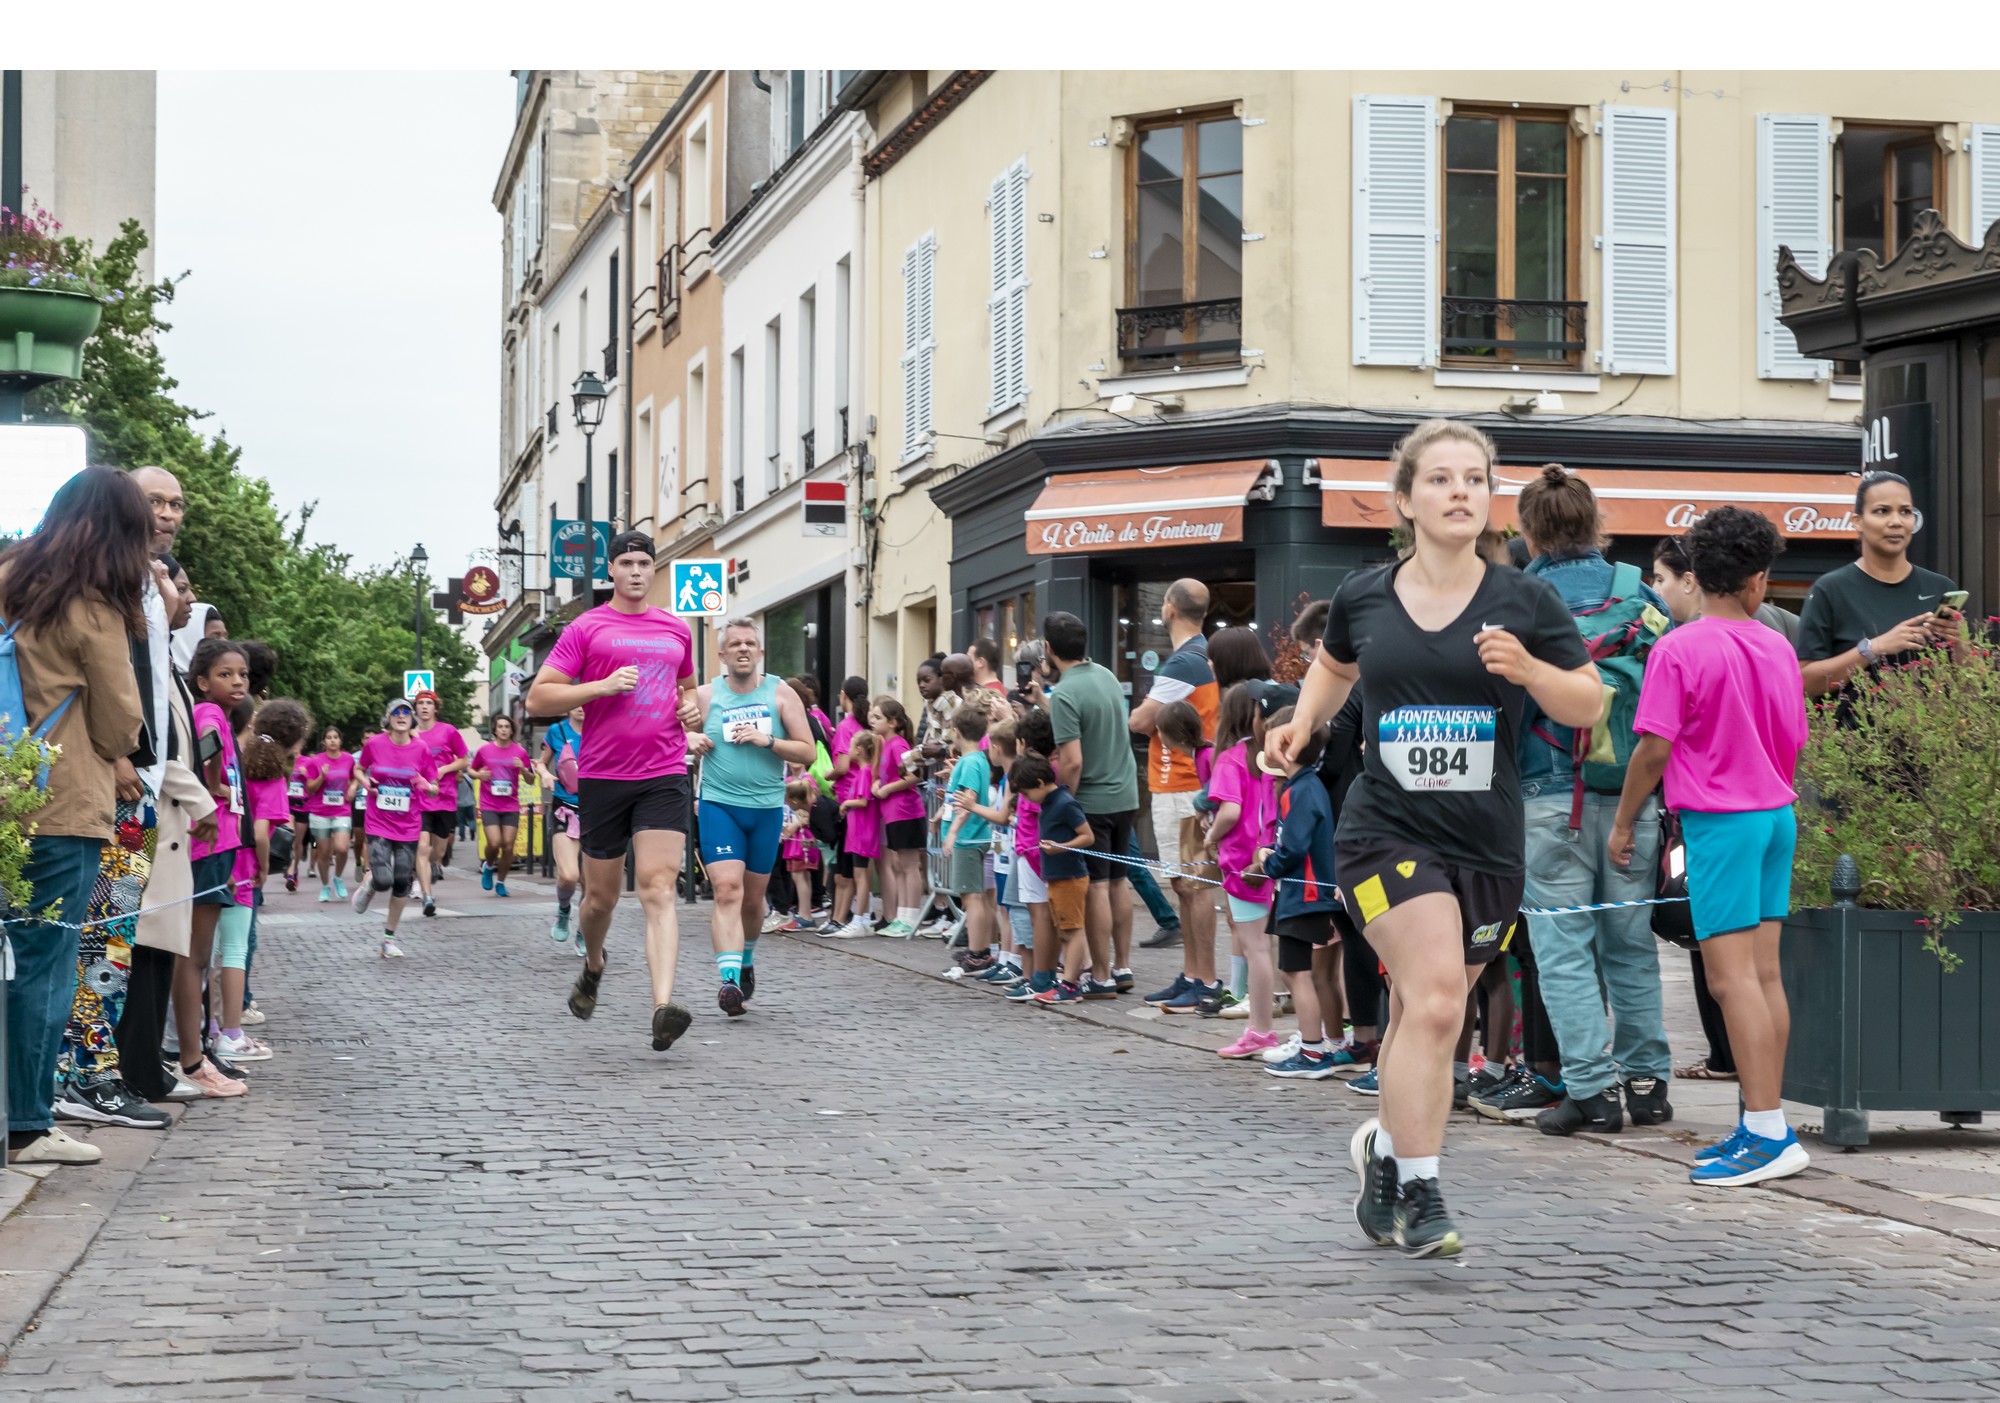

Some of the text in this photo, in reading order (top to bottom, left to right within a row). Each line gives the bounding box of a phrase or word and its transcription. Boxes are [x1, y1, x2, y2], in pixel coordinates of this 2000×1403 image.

[1665, 503, 1709, 528] Ar
[558, 524, 601, 541] GARAE
[1118, 521, 1139, 541] de
[1142, 516, 1224, 542] Fontenay
[1381, 709, 1494, 725] LA FONTENAISIENNE
[1408, 747, 1469, 776] 984
[384, 797, 402, 807] 941
